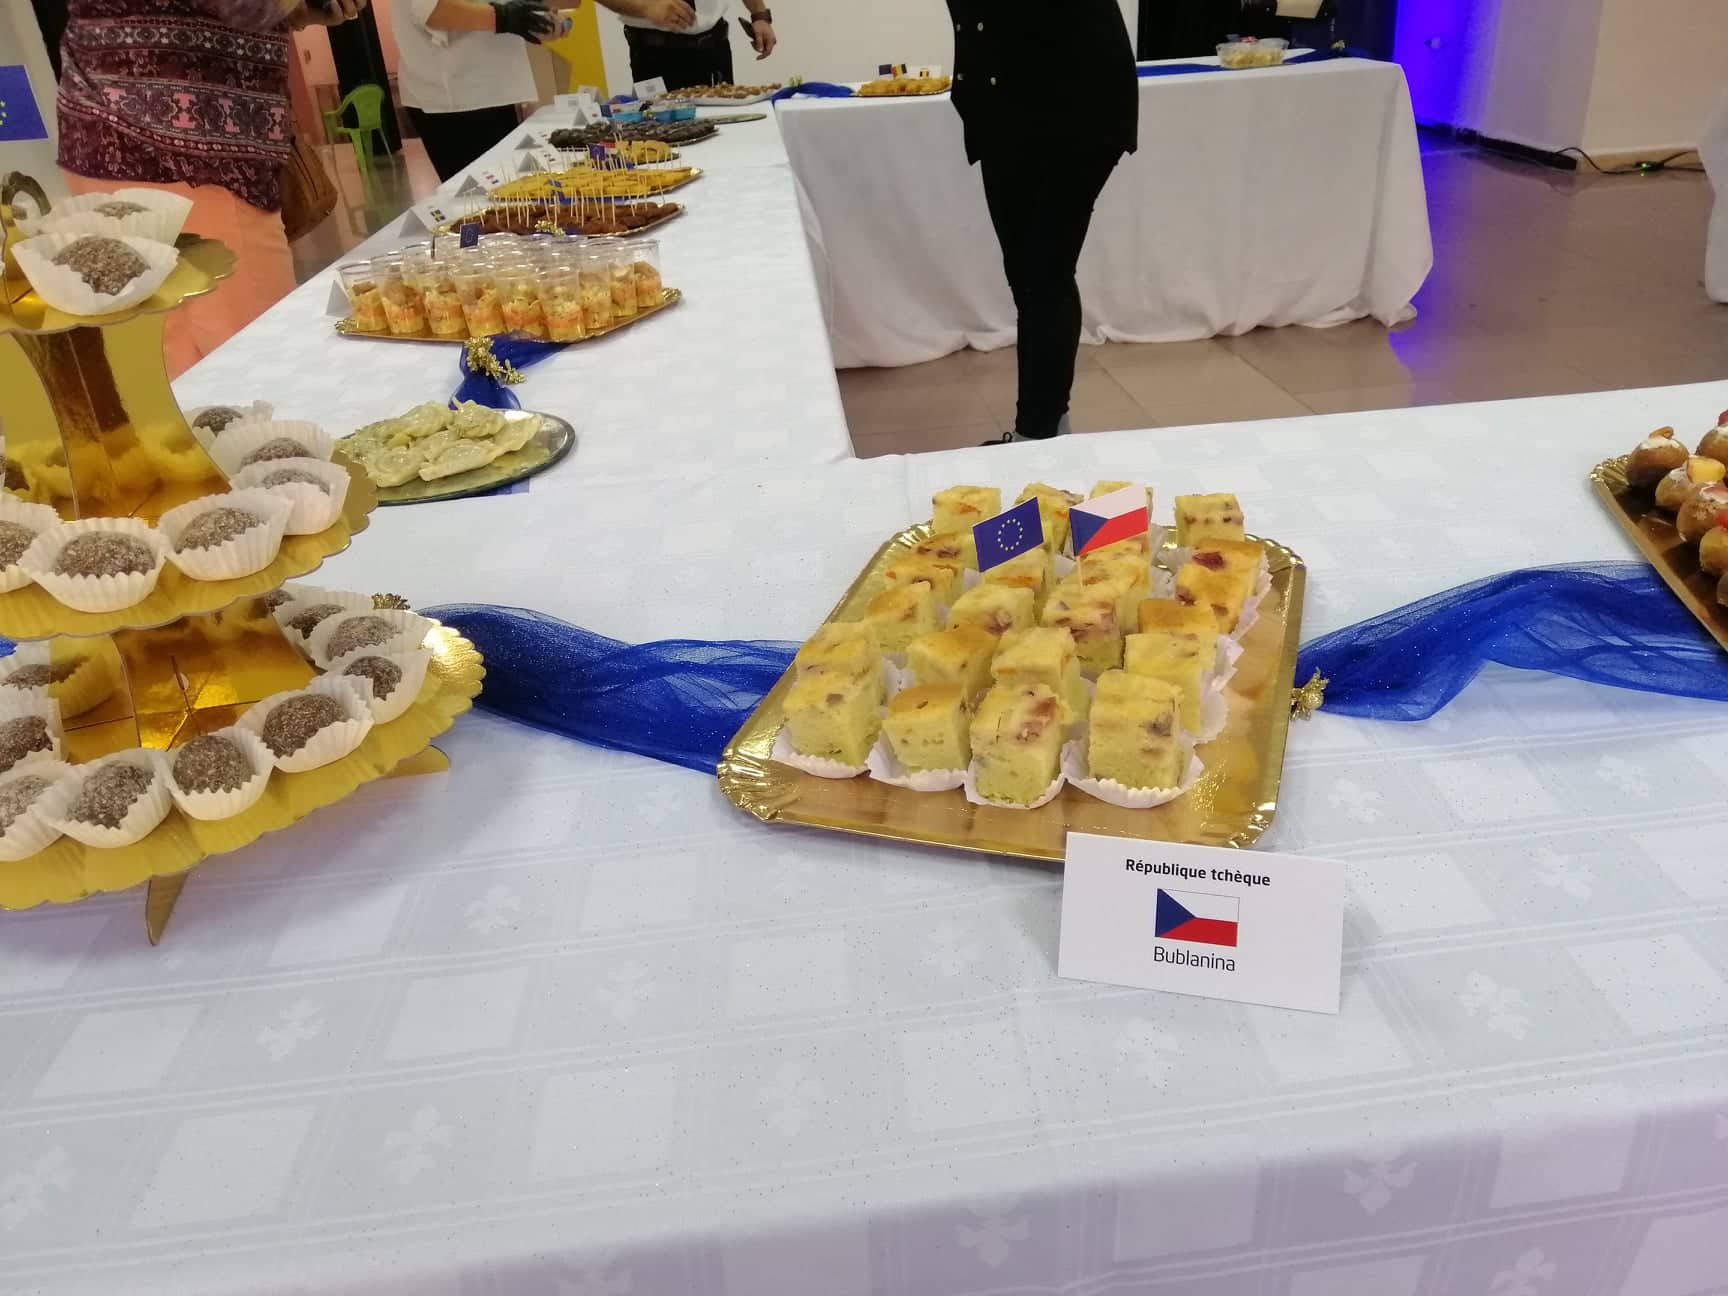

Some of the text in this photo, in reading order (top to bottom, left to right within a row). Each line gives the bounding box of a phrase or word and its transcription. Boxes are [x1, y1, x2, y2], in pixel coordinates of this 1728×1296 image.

[1125, 859, 1271, 886] République tchèque
[1153, 946, 1235, 972] Bublanina
